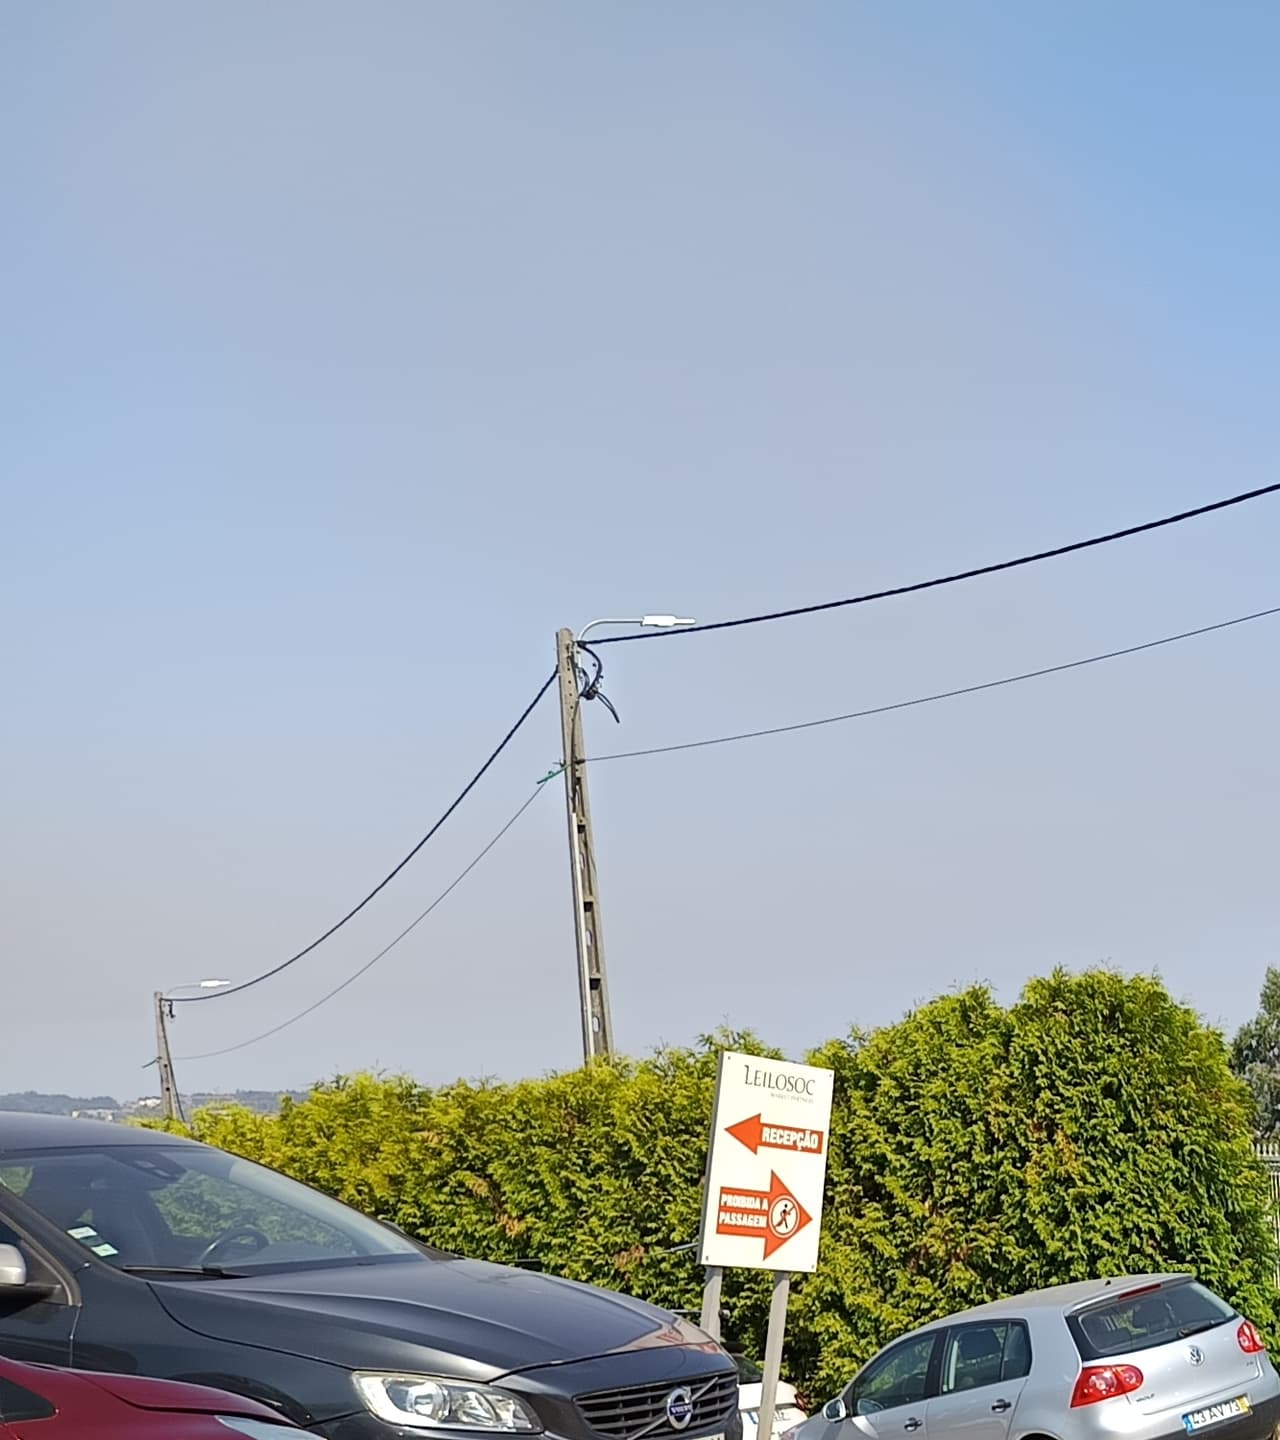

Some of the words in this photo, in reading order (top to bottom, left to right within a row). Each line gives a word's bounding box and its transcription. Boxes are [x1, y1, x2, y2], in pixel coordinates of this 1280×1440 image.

[744, 1064, 816, 1096] LEILOSOC
[761, 1126, 819, 1151] RECEPÇÃO
[761, 1198, 769, 1211] A
[718, 1211, 768, 1228] PASSAGEM
